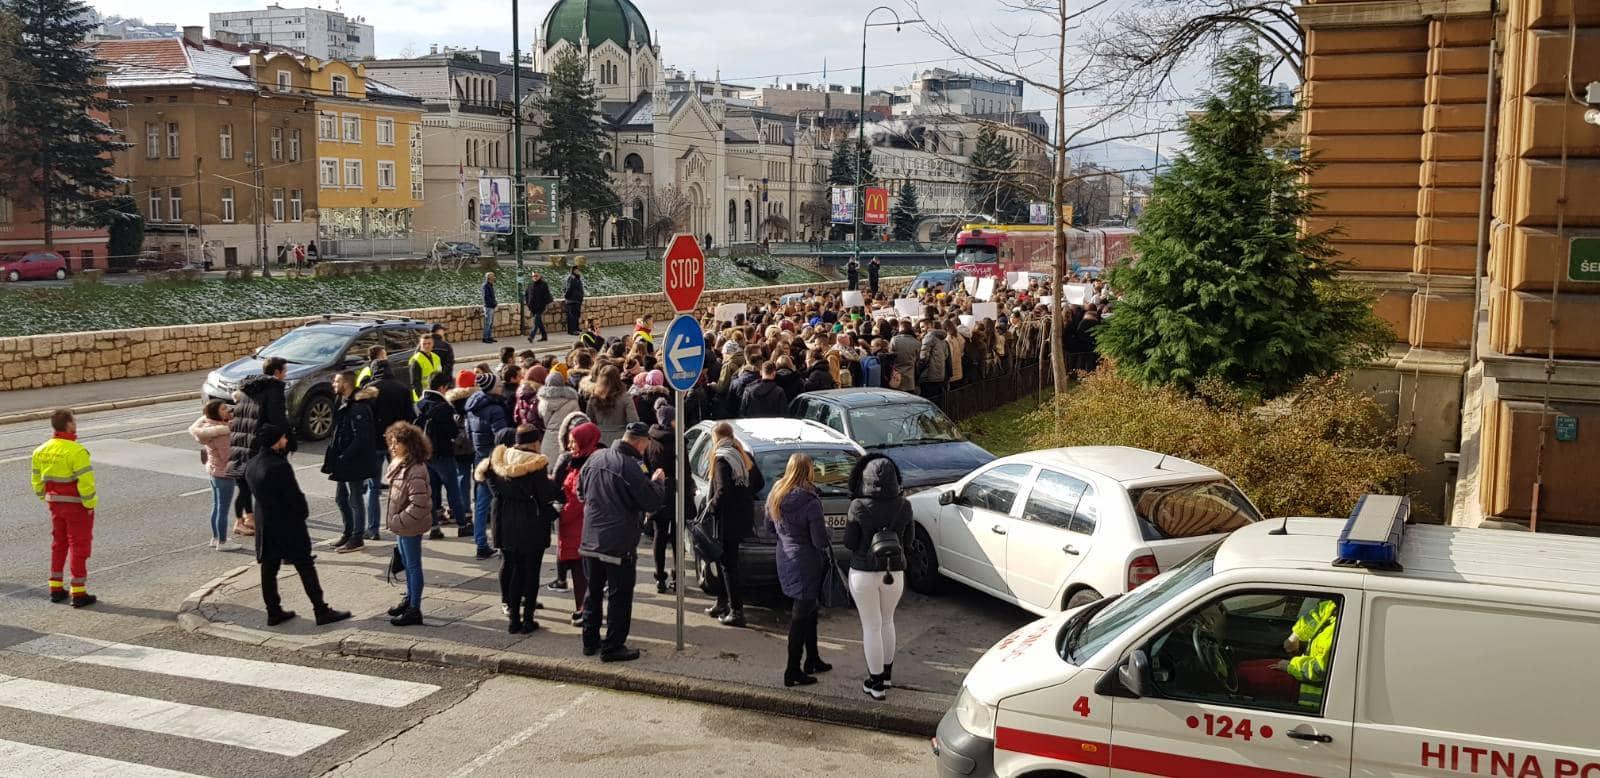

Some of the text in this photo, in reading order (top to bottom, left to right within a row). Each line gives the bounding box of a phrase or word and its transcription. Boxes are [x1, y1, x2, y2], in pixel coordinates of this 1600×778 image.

[670, 258, 700, 289] STOP
[1580, 259, 1600, 272] ŠE
[1073, 696, 1090, 717] 4
[1204, 713, 1253, 741] 124
[1421, 742, 1544, 778] HITNA
